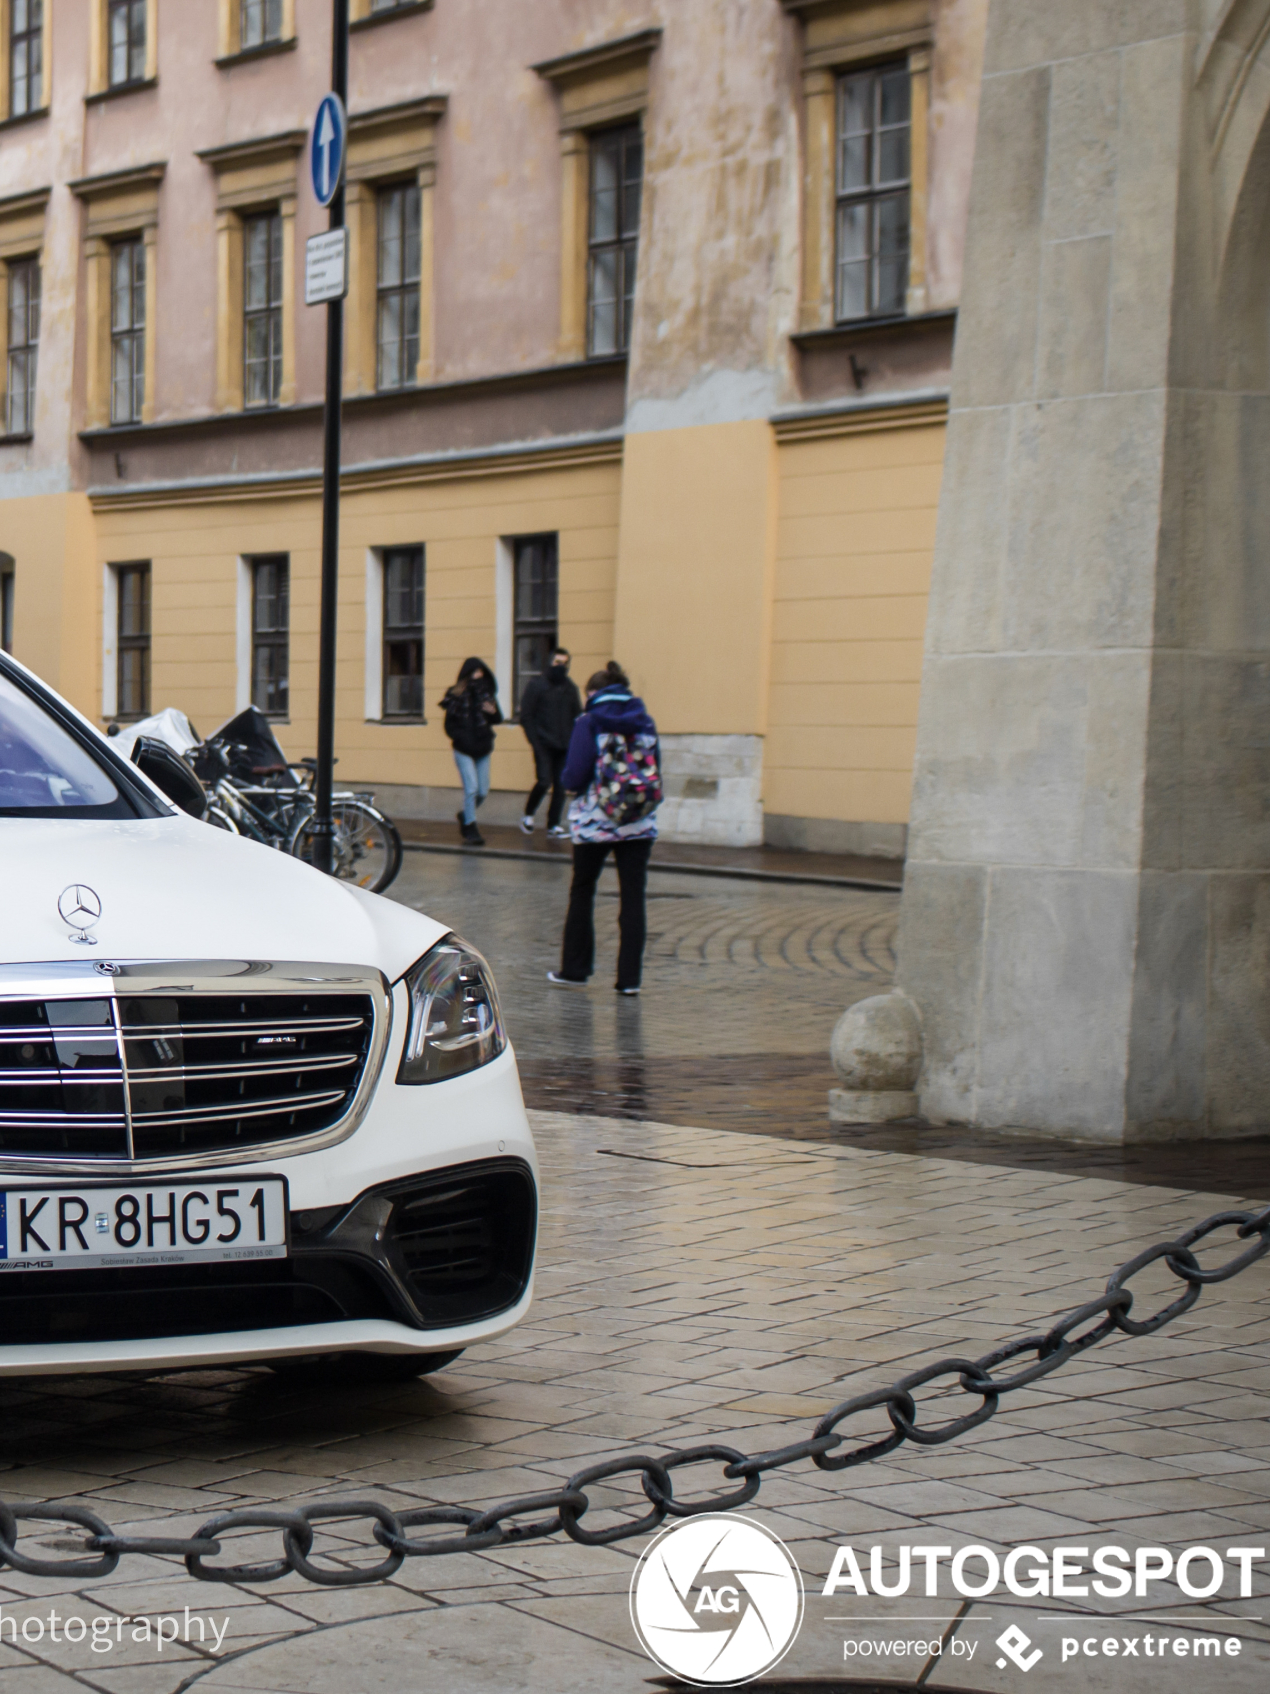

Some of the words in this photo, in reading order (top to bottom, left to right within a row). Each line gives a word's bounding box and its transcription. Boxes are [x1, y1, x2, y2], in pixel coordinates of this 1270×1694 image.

[19, 1196, 90, 1253] KR
[114, 1187, 266, 1248] 8HG51
[136, 1255, 159, 1264] Zasada
[160, 1254, 185, 1263] Kraków
[12, 1260, 54, 1269] AMG
